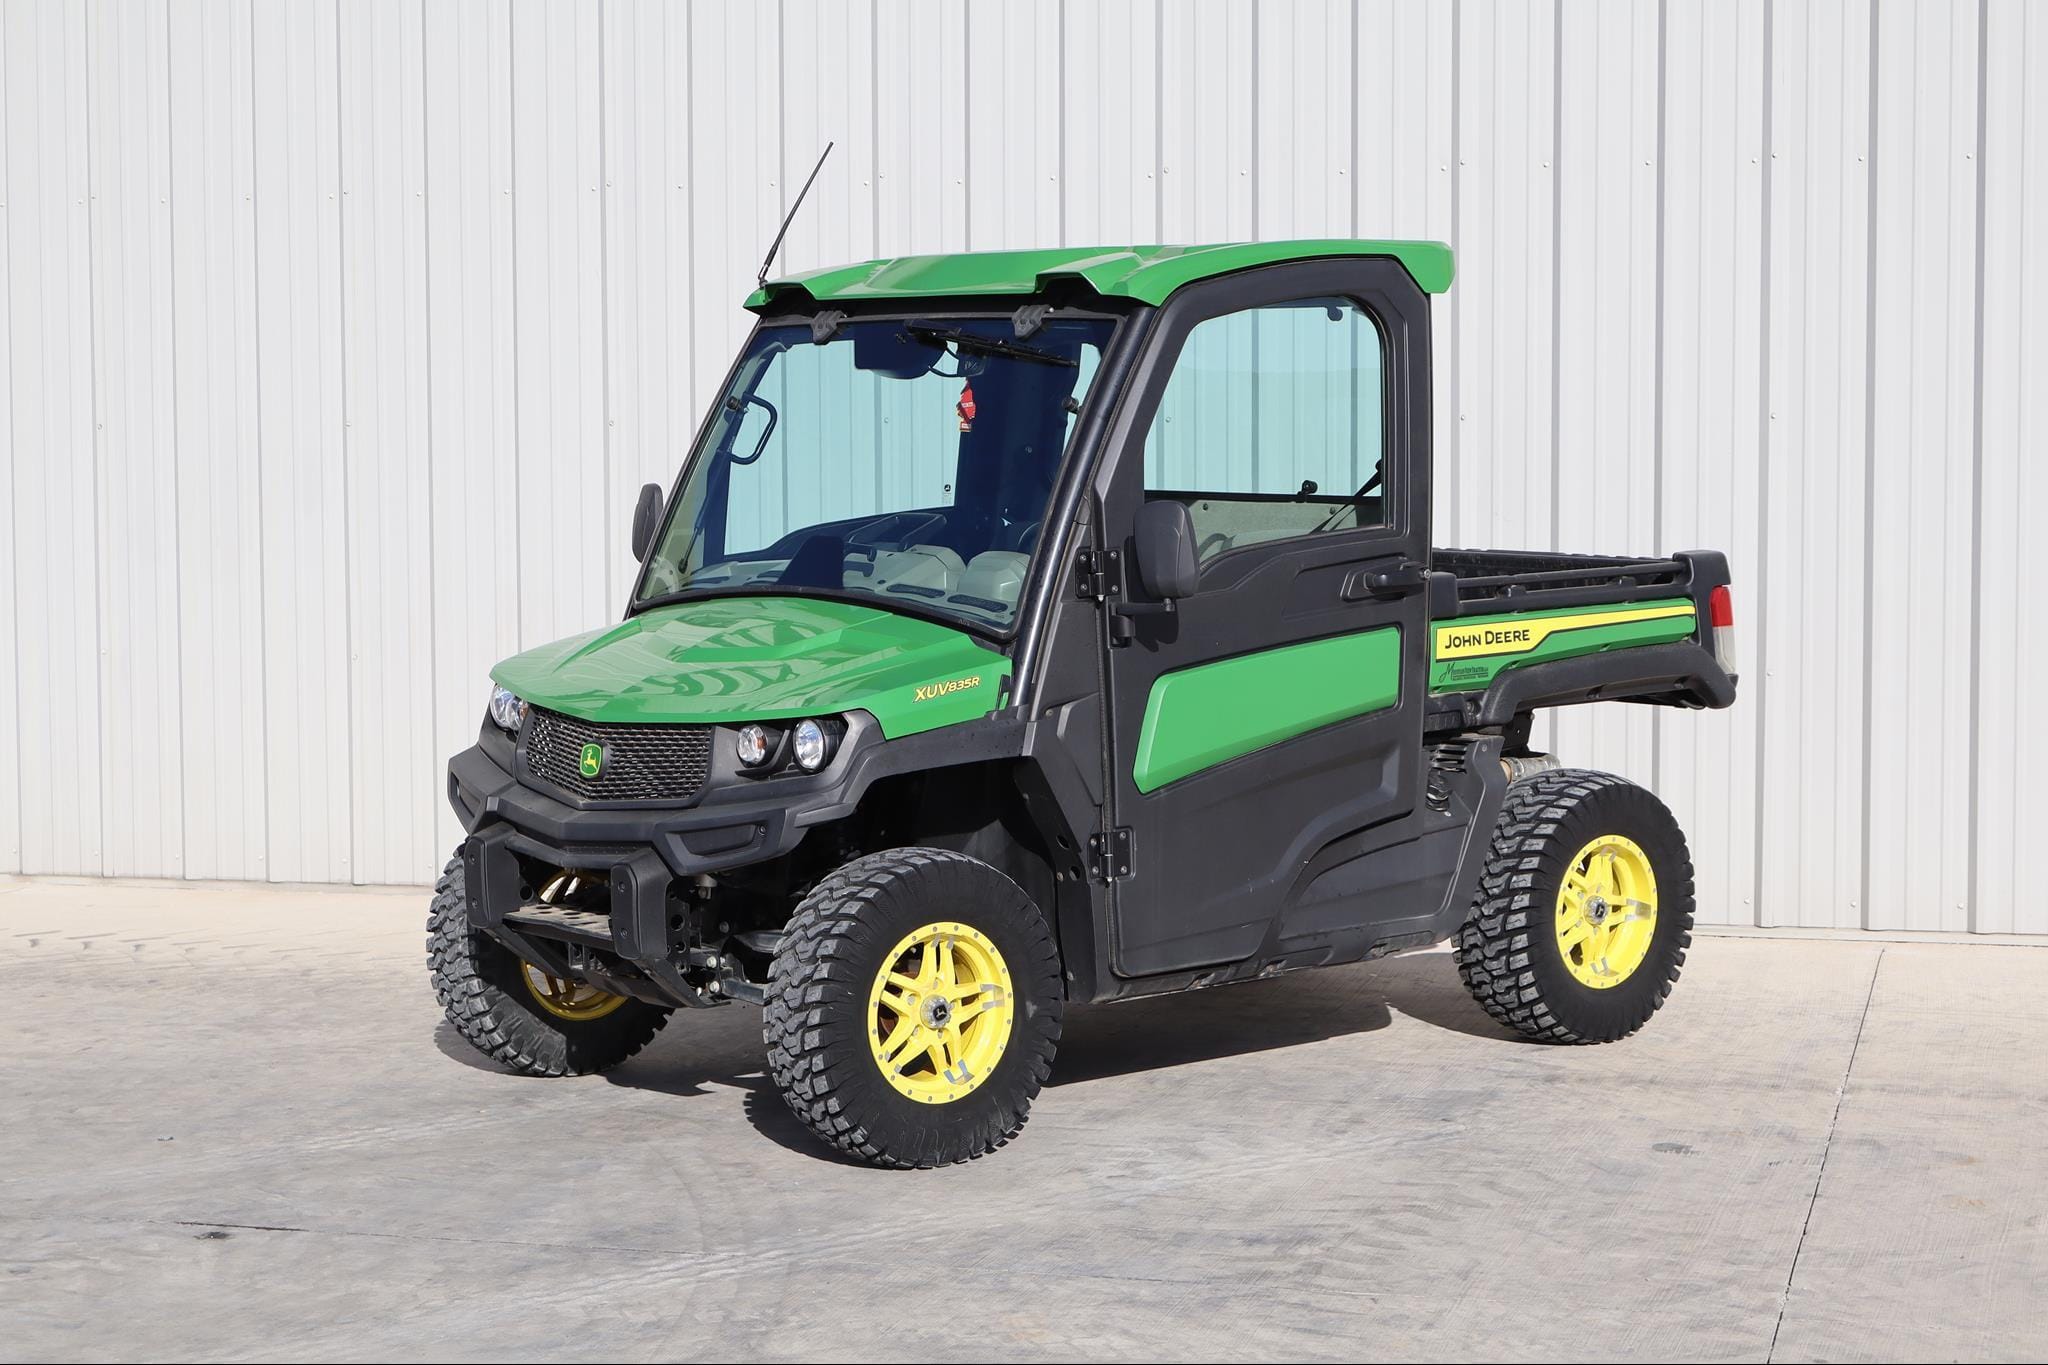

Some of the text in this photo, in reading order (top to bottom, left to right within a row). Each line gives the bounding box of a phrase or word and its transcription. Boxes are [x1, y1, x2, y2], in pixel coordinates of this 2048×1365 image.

[1444, 629, 1530, 649] JOHN DEERE
[913, 676, 980, 703] XUV835R
